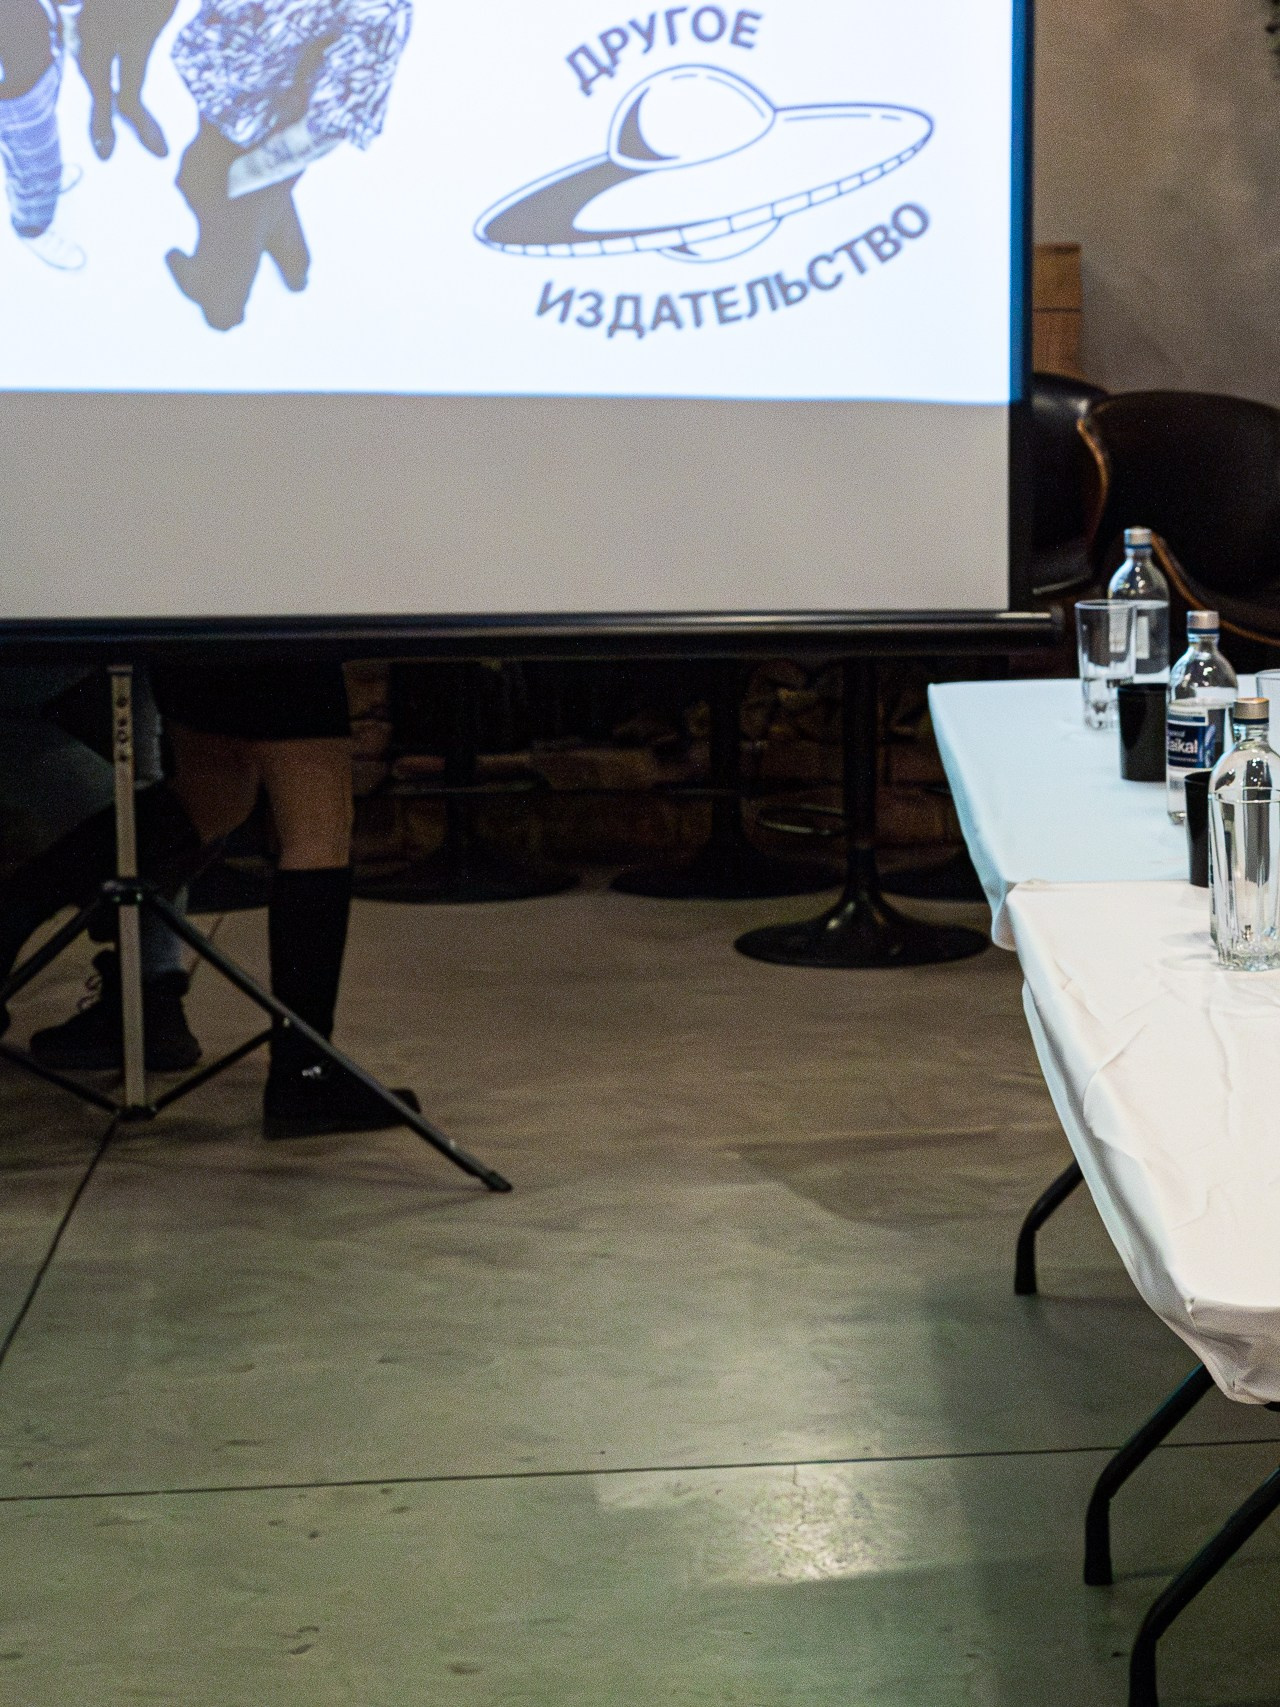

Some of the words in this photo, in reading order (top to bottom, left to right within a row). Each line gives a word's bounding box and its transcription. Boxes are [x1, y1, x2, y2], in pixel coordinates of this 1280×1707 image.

[565, 4, 763, 97] ДРУГОЕ
[536, 201, 932, 341] ИЗДАТЕЛЬСТВО
[1167, 738, 1198, 754] aikal
